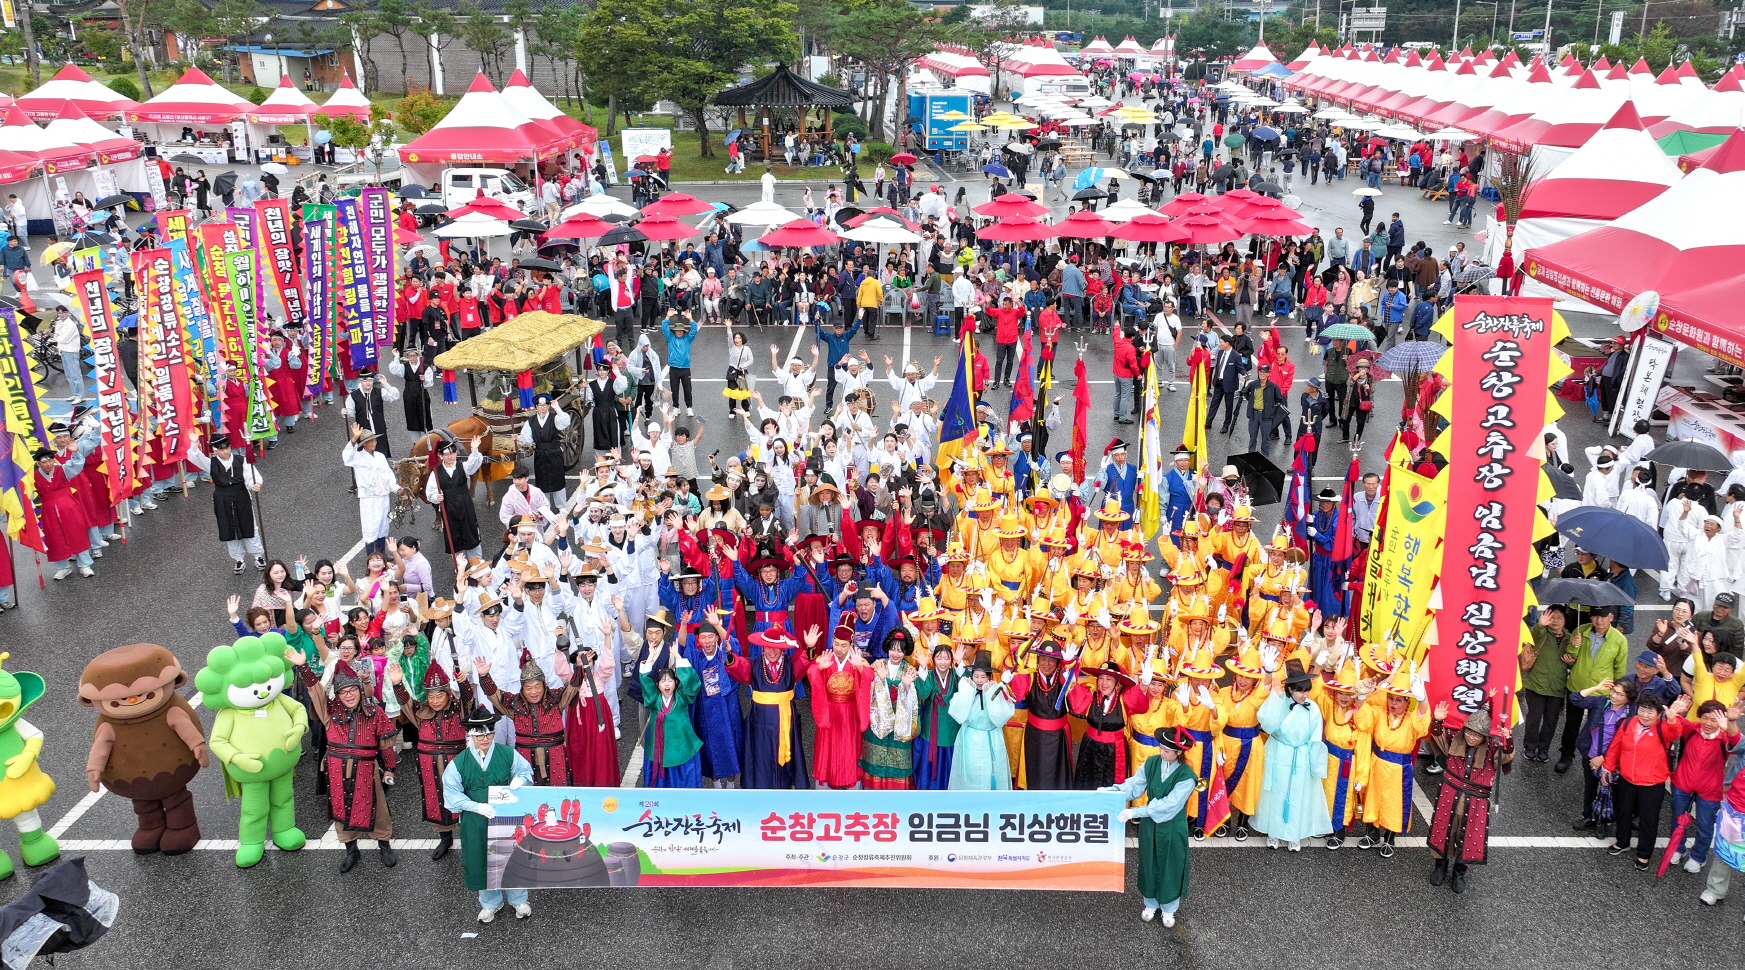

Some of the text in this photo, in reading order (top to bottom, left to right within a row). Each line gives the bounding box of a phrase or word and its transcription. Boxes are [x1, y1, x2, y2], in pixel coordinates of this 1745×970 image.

[450, 152, 484, 161] 통합안내소
[264, 206, 287, 245] 천년의
[367, 194, 385, 224] 군민
[273, 247, 293, 284] 장맛!
[308, 224, 323, 278] 세계인의
[370, 226, 388, 269] 모두가
[344, 205, 376, 360] 천혜자연의 물을 즐기는
[371, 272, 389, 312] 행복한
[153, 256, 184, 366] 순창장류소스
[1463, 311, 1546, 340] 순창장류축제
[1668, 317, 1711, 346] 순창문화원과
[1711, 334, 1743, 359] 함께하는
[83, 280, 109, 334] 천년의
[103, 390, 127, 444] 백년의
[1452, 339, 1524, 716] 순창고추장 임금님 진상행렬
[638, 800, 659, 808] 제20회
[622, 809, 741, 844] 순창장류축제
[760, 811, 1110, 844] 순창고추장 임금님 진상행렬
[852, 854, 913, 862] 순창장류축제추진위원회
